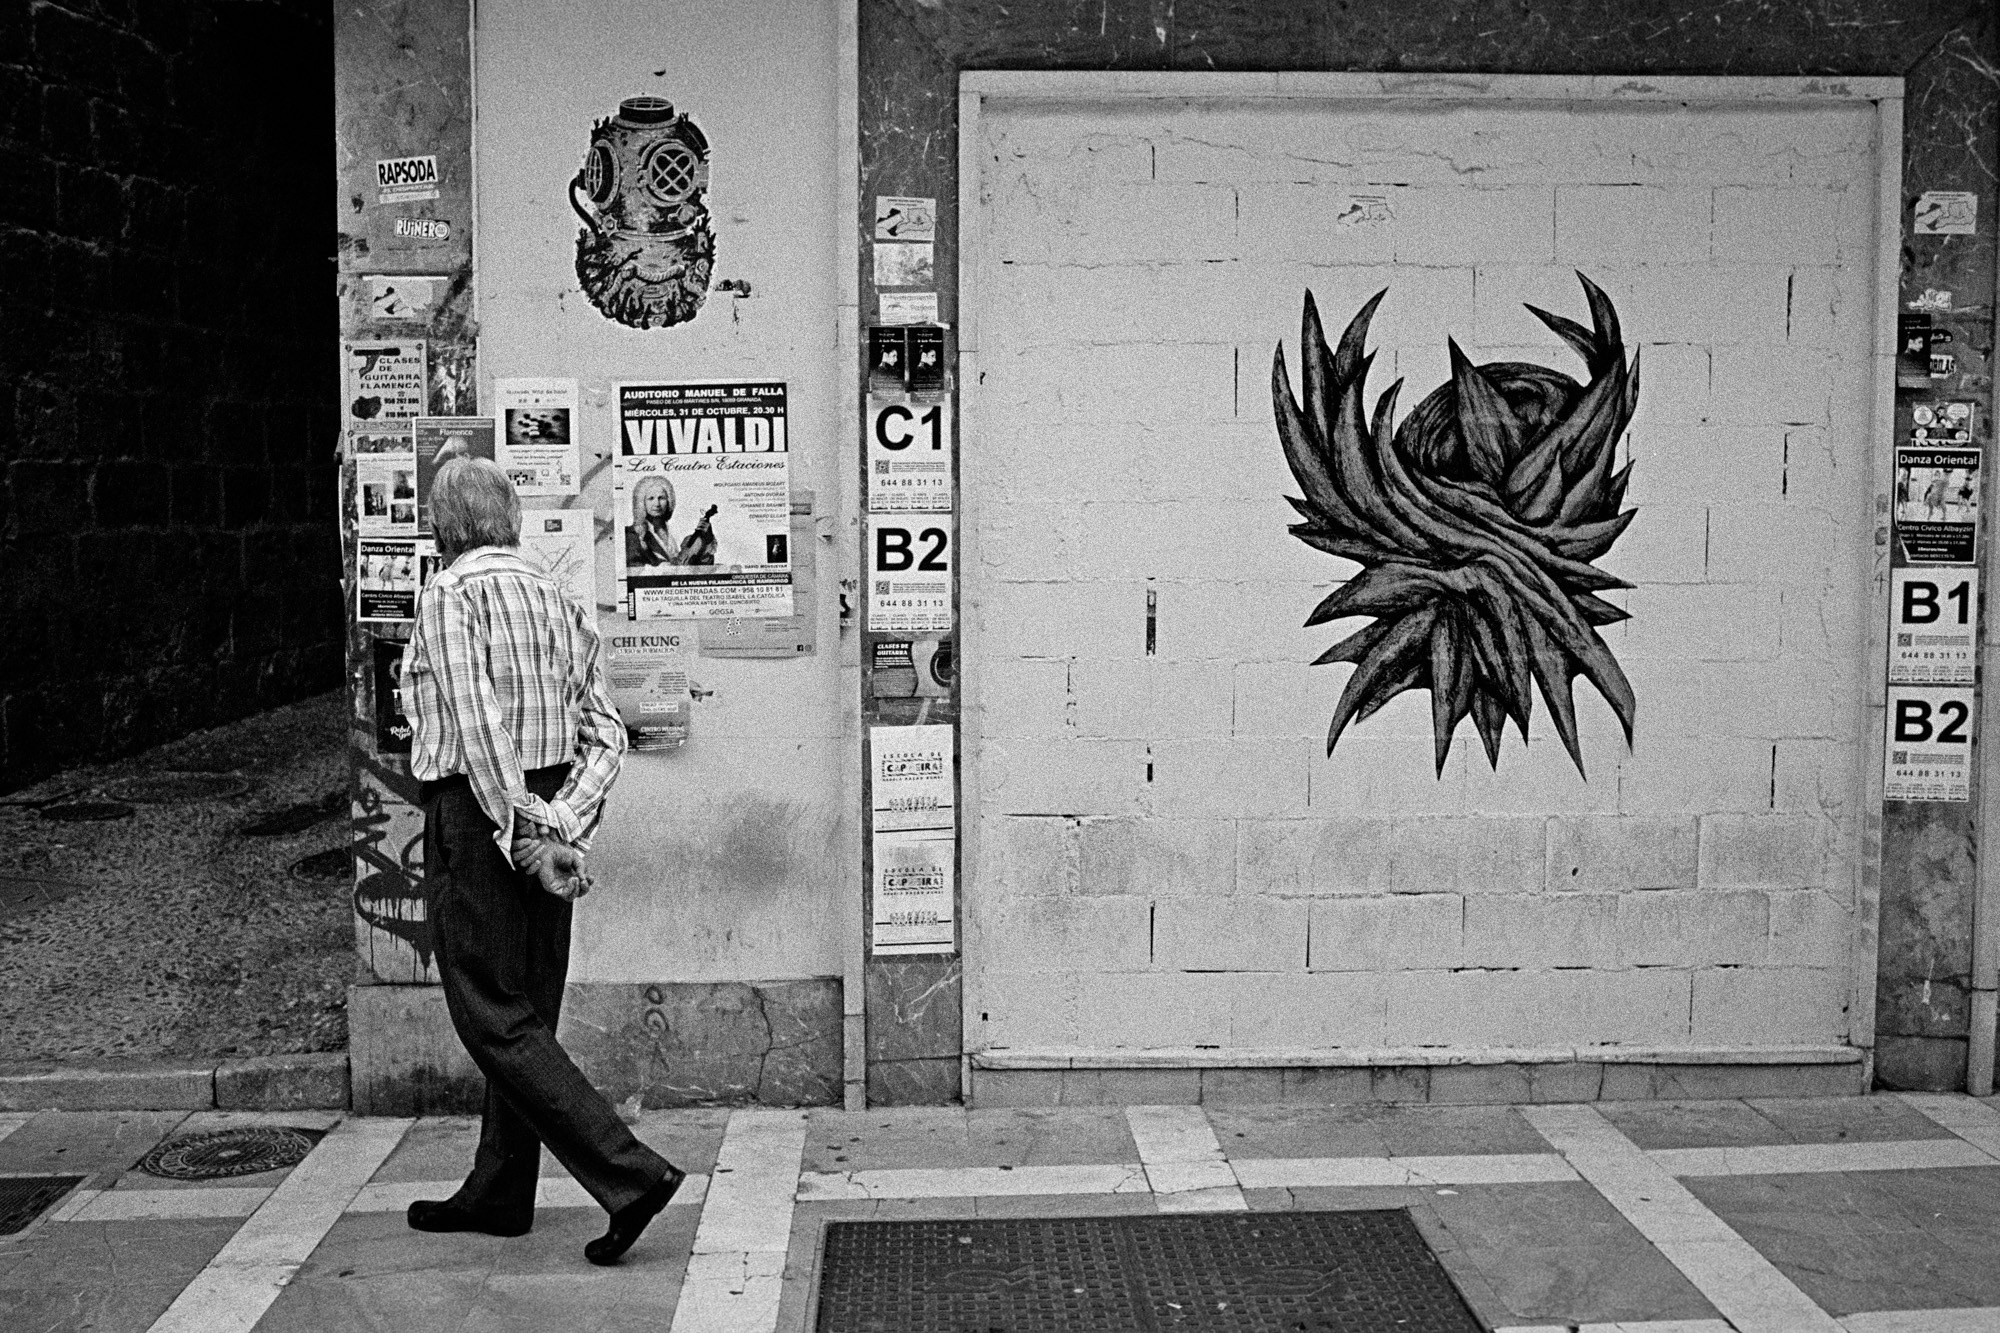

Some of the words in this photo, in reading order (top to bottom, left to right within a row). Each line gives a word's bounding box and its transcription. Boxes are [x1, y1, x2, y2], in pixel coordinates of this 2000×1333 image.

[378, 159, 436, 185] RAPSODA
[623, 389, 679, 399] AUDITORIO
[685, 388, 727, 398] MANUEL
[732, 388, 747, 396] DE
[752, 387, 784, 396] FALLA
[624, 408, 677, 417] MIÉRCOLES,
[679, 408, 688, 416] 31
[691, 408, 704, 416] DE
[706, 407, 751, 415] OCTUBRE,
[753, 406, 775, 414] 20.30
[777, 406, 784, 414] H
[439, 428, 473, 436] Flamenco
[875, 404, 942, 451] C1
[624, 416, 785, 455] VIVALDI
[626, 457, 656, 472] Las
[660, 456, 712, 472] Cuatro
[715, 455, 785, 471] Estaciones
[1900, 454, 1931, 464] Danza
[1934, 454, 1977, 465] Oriental
[1897, 523, 1919, 531] Centro
[361, 545, 383, 553] Danza
[384, 545, 415, 553] Oriental
[876, 527, 948, 571] B2
[880, 599, 897, 607] 644
[901, 599, 912, 607] 88
[917, 599, 927, 607] 31
[933, 599, 943, 607] 13
[1901, 580, 1970, 624] B1
[612, 636, 637, 648] CHI
[640, 635, 680, 648] KUNG
[1901, 651, 1919, 659] 644
[1923, 651, 1935, 659] 88
[1894, 699, 1969, 743] B2
